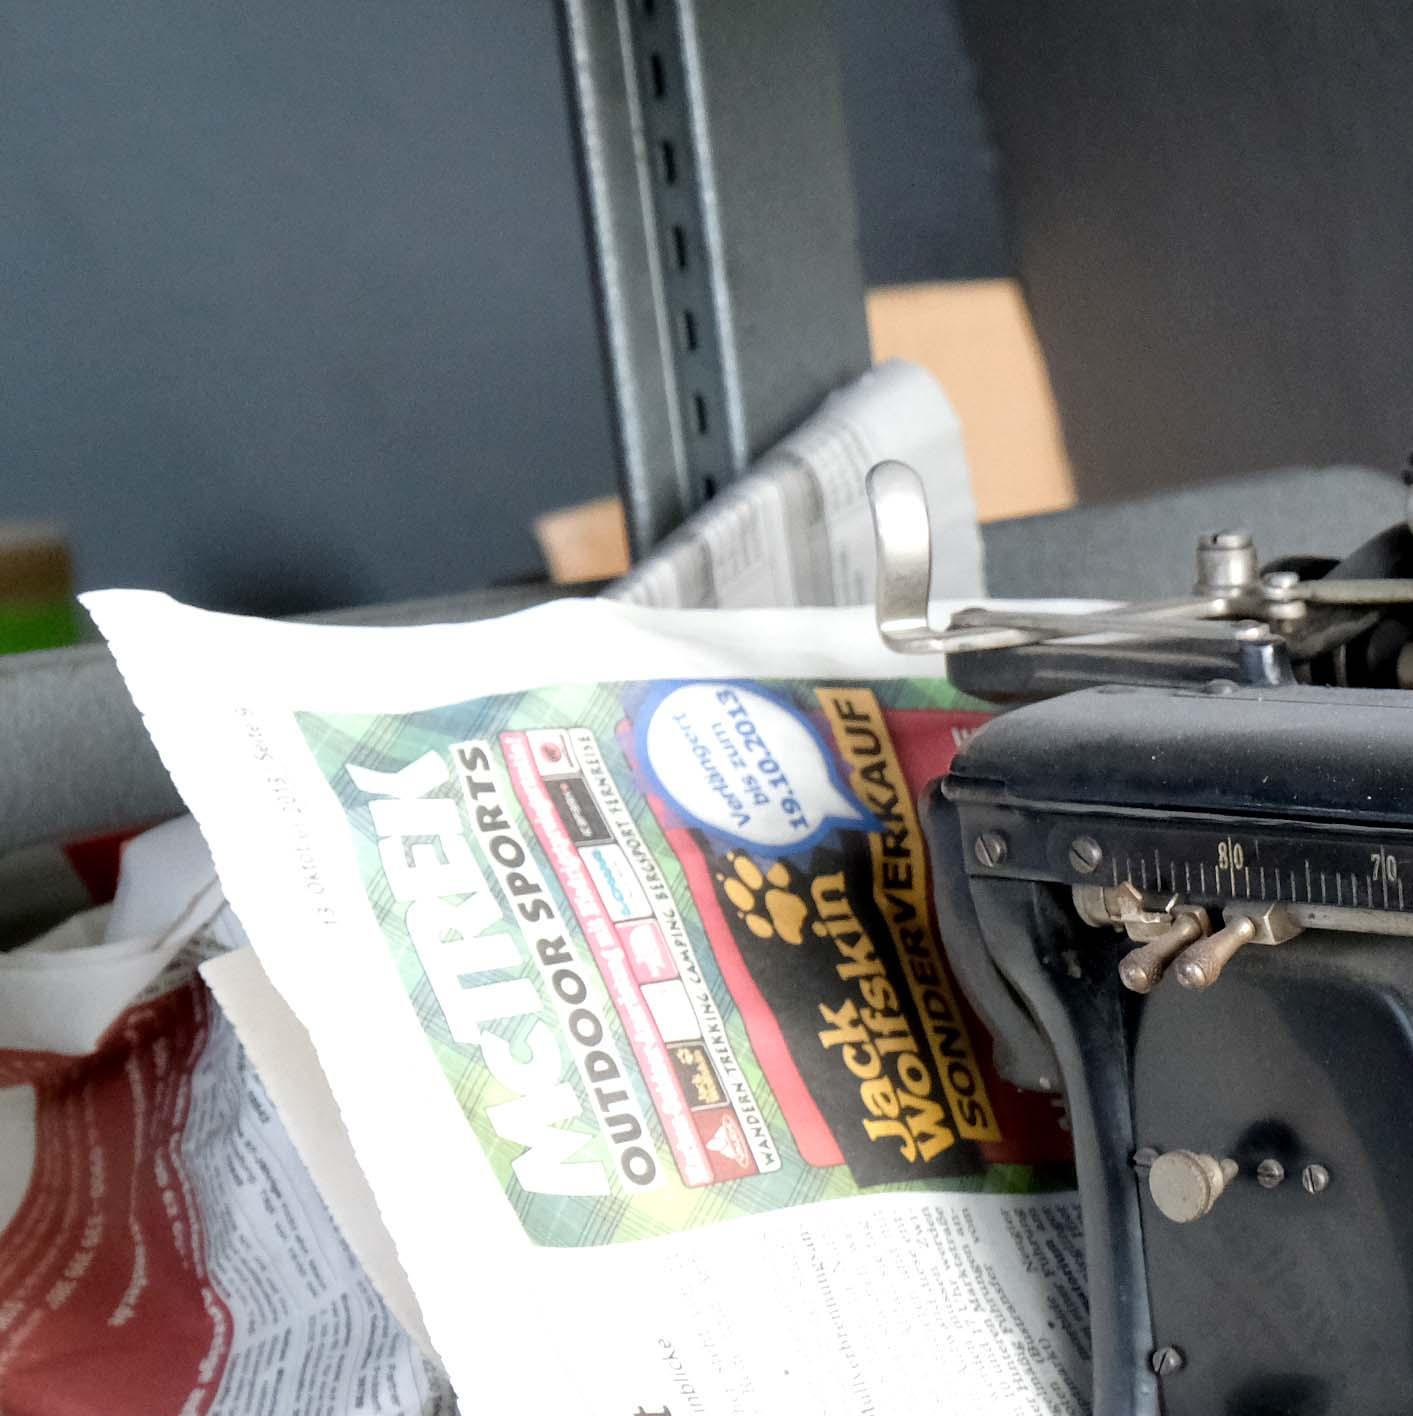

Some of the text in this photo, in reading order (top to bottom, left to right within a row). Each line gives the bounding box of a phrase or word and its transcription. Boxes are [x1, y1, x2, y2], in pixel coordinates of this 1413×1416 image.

[673, 713, 750, 827] Verlängert
[712, 722, 770, 805] bis zum
[716, 689, 808, 829] 19.10.2013
[459, 745, 554, 922] SPORTS
[1217, 840, 1244, 871] 80
[1372, 850, 1397, 883] 70
[662, 909, 702, 984] CAMPING
[834, 700, 983, 1129] SONDERVERKAUF
[537, 935, 657, 1186] OUTDOOR
[697, 993, 737, 1076] TREKKING
[810, 871, 955, 1164] Wolfskin
[731, 1082, 774, 1166] WANDERN
[817, 1000, 917, 1164] Jack
